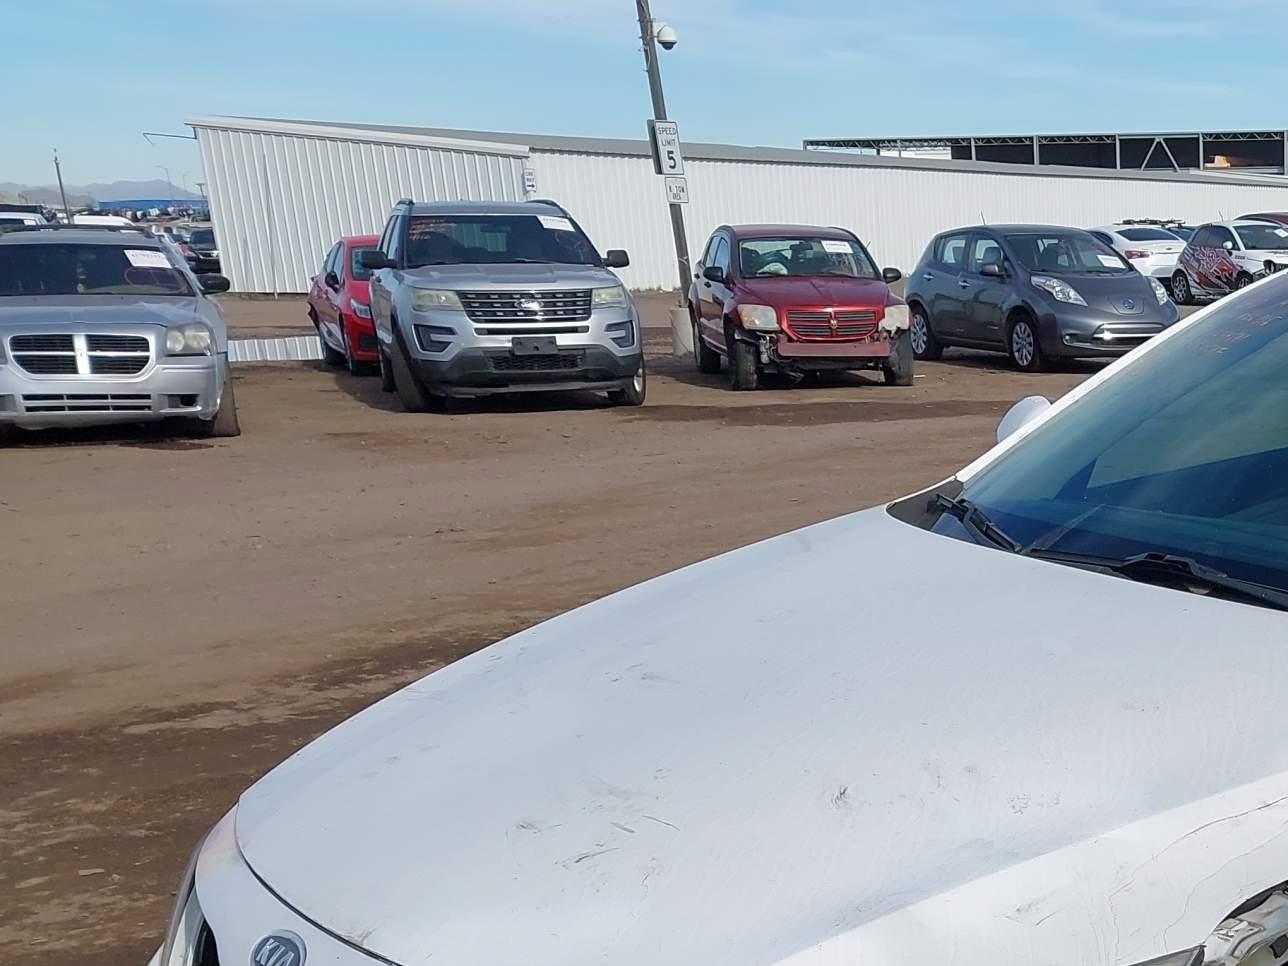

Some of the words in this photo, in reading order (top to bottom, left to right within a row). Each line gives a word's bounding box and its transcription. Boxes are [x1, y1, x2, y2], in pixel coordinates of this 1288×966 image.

[658, 127, 677, 135] SPEED
[661, 138, 676, 147] LIMIT
[667, 150, 677, 169] 5
